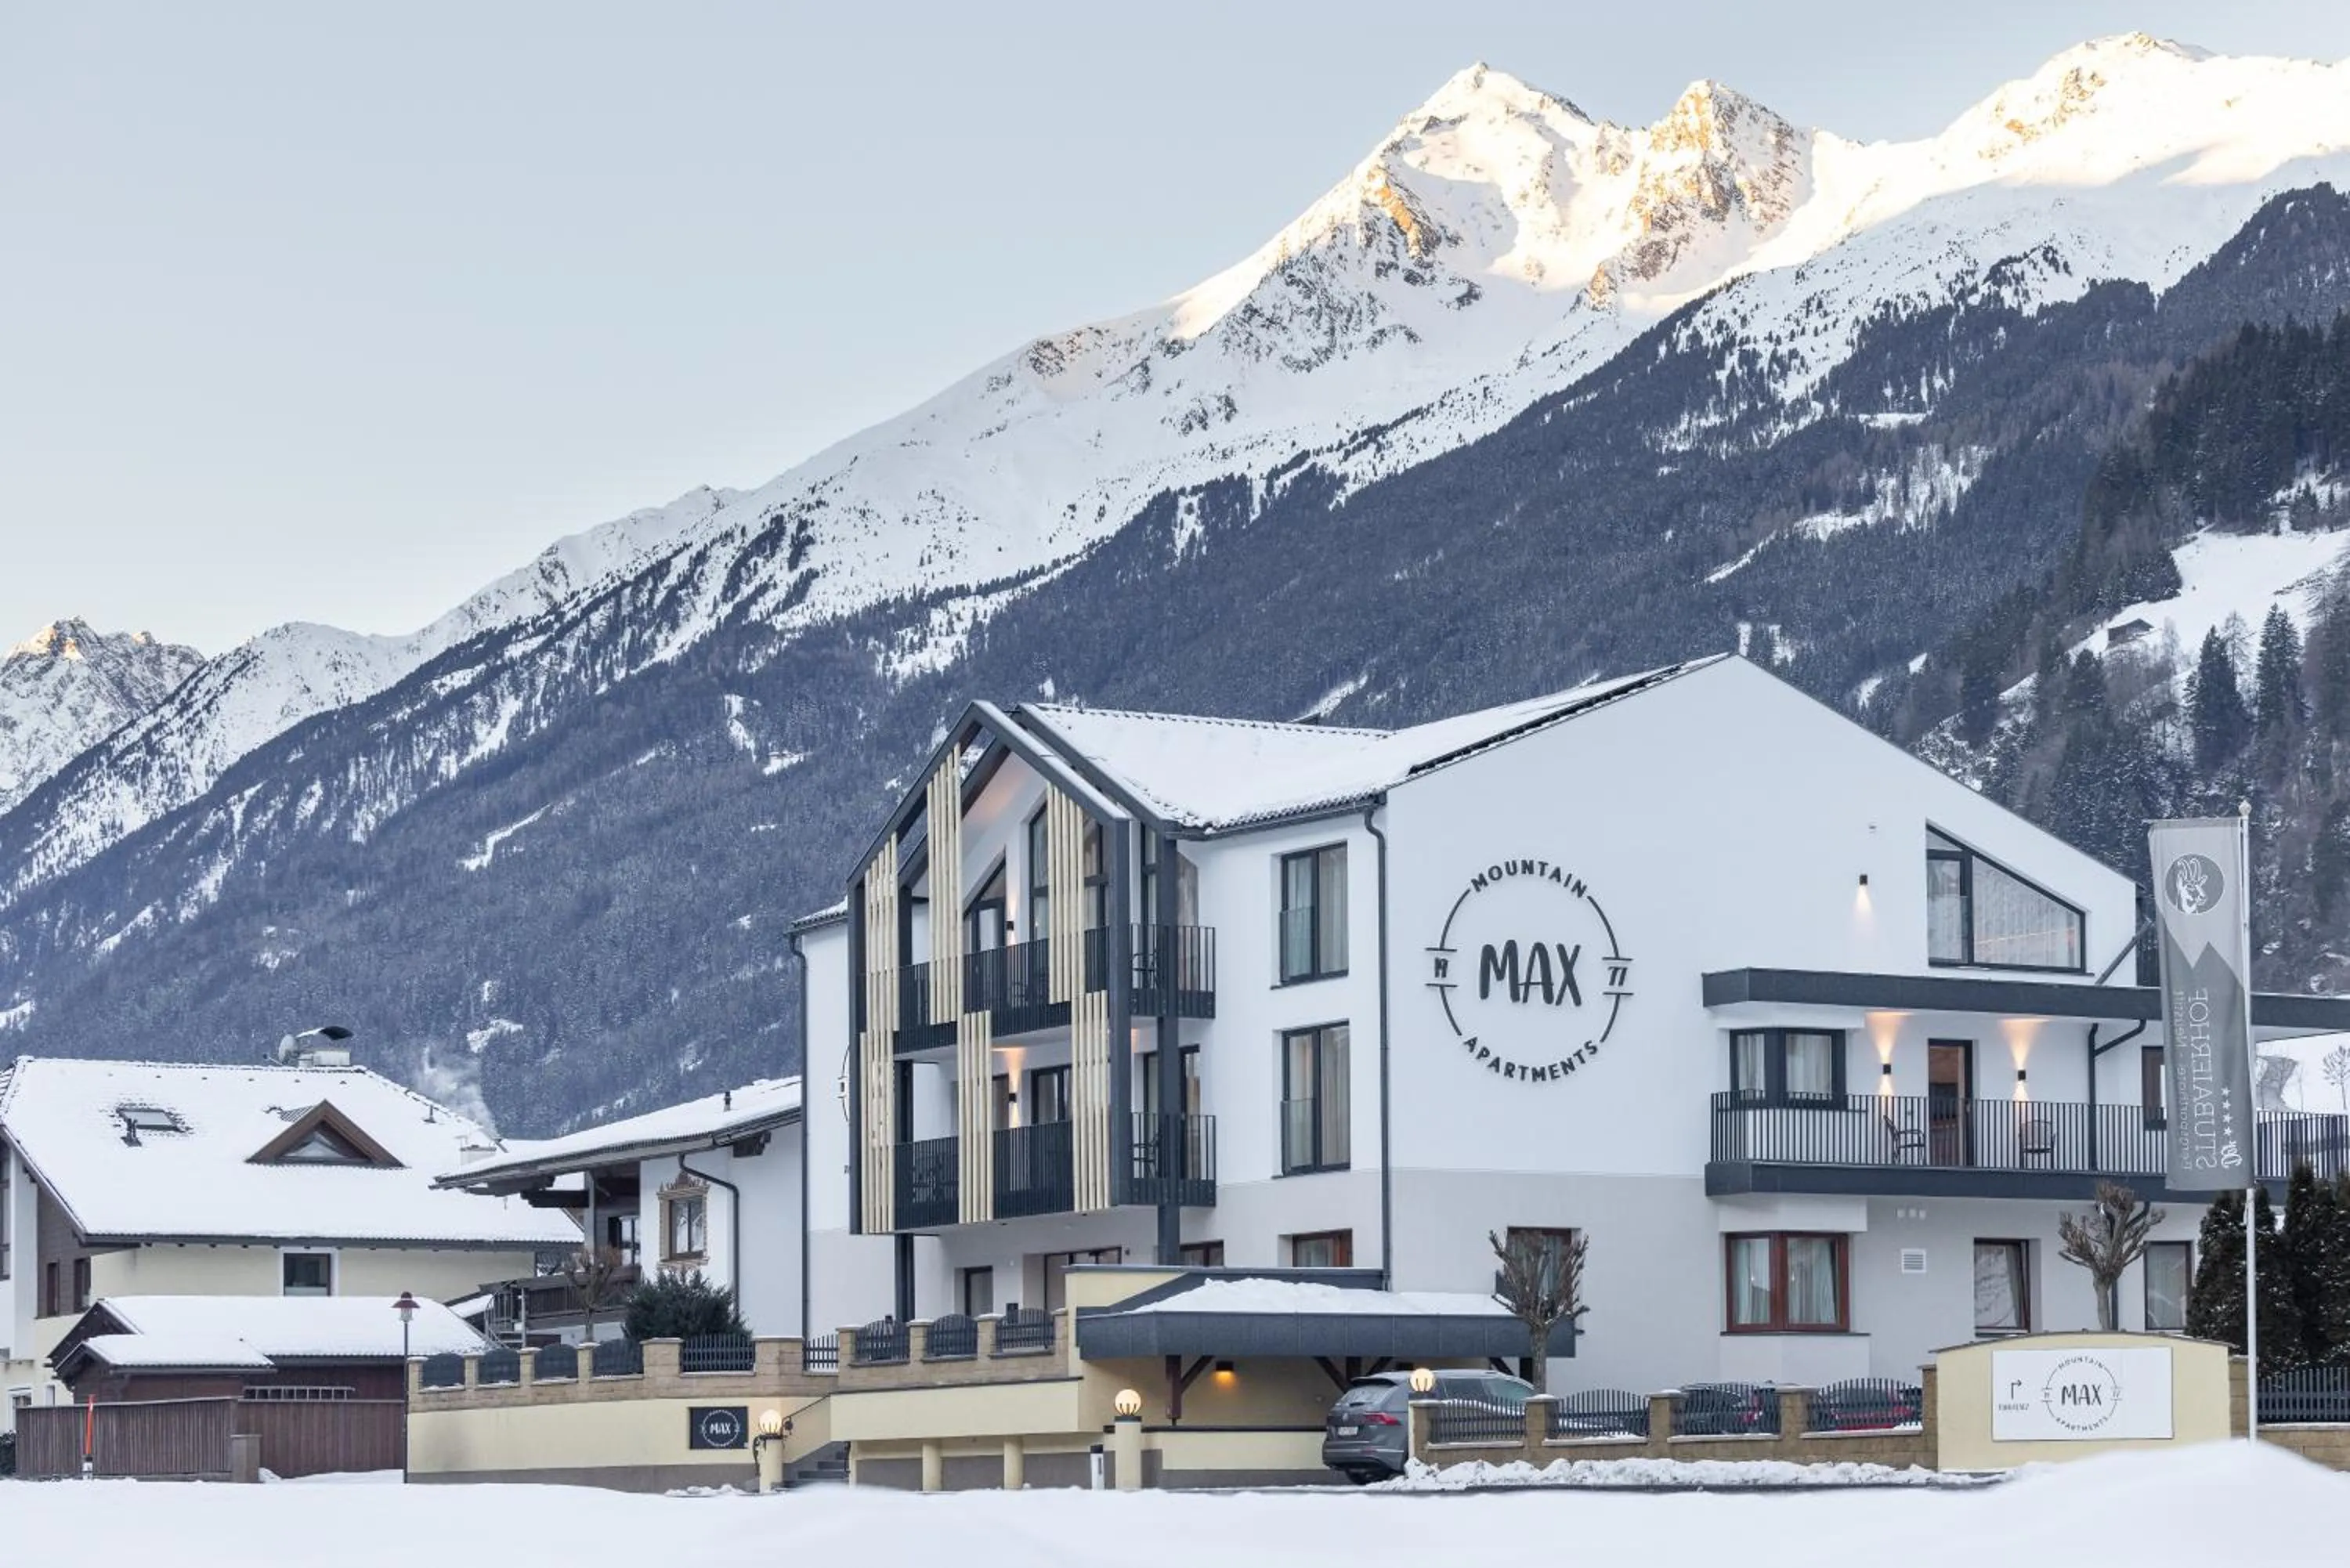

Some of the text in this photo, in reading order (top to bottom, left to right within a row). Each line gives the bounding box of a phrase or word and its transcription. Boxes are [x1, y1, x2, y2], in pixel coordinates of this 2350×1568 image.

[1470, 859, 1588, 898] MOUNTAIN
[1480, 939, 1582, 1006] MAX
[1463, 1036, 1599, 1082] APARTMENTS
[2058, 1356, 2104, 1370] MOUNTAIN
[2061, 1382, 2102, 1407] MAX
[709, 1422, 731, 1435] MAX
